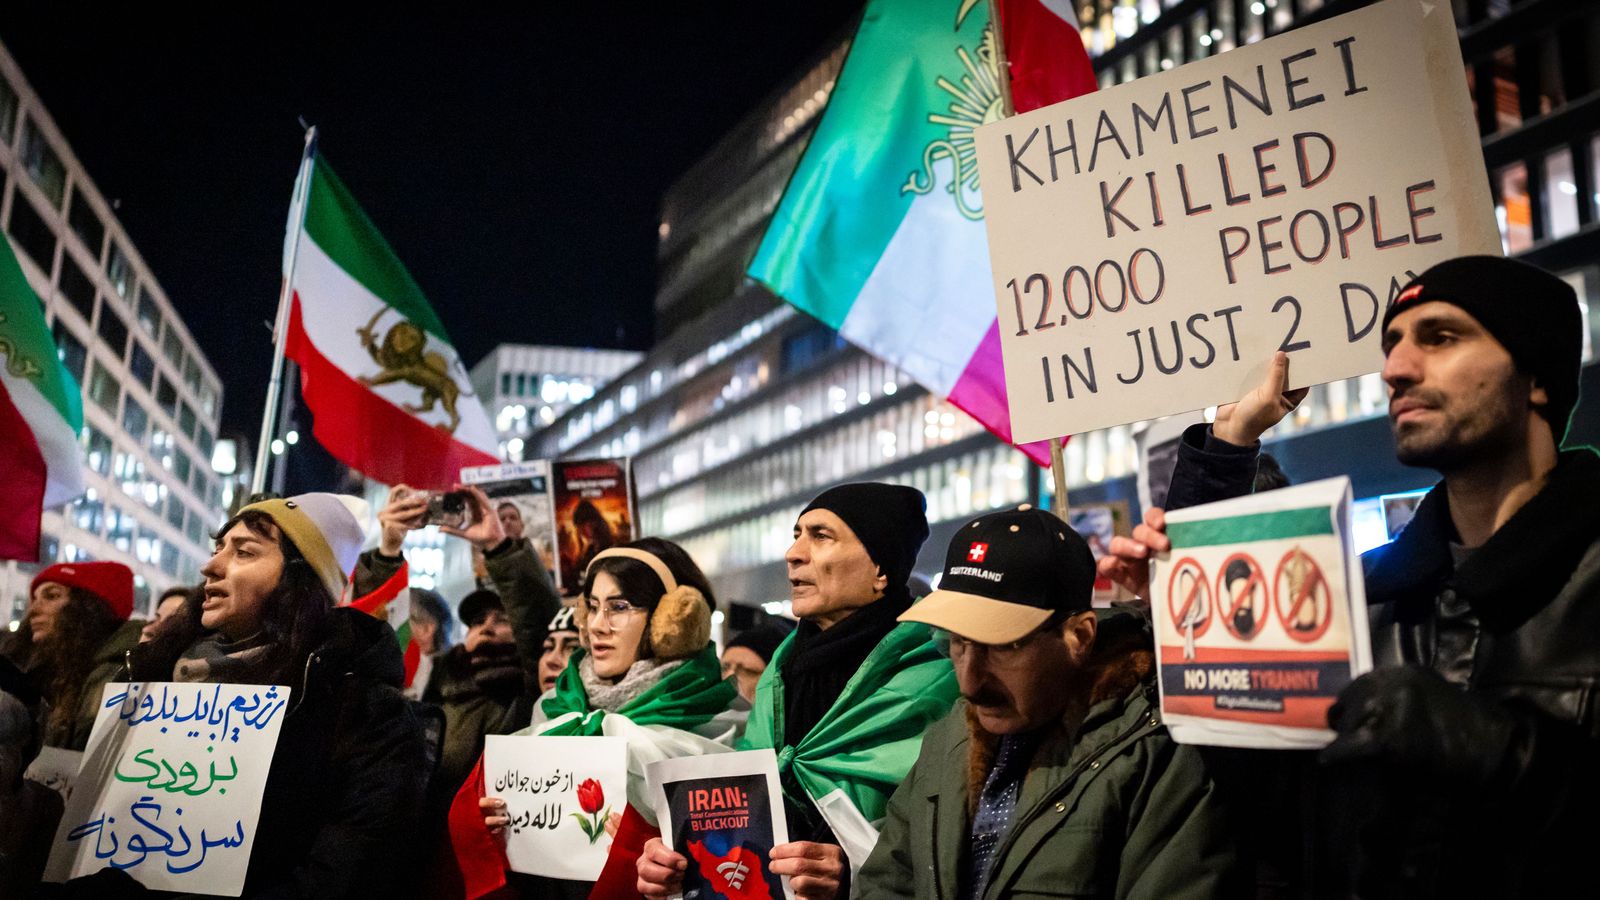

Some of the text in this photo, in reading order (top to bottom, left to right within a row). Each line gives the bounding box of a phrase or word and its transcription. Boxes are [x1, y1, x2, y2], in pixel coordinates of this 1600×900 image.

[1005, 36, 1368, 192] KHAMENEI
[1100, 132, 1336, 238] KILLED
[1218, 179, 1442, 285] PEOPLE
[1042, 270, 1418, 402] IN JUST 2 DA
[949, 566, 1002, 582] SWITZERLAND
[1184, 669, 1319, 691] NO MORE TYRANNY
[173, 684, 224, 741] باید
[221, 685, 286, 743] رژیم
[114, 745, 238, 796] بزودی
[495, 768, 573, 794] از خون جوانان
[530, 803, 562, 830] لاله
[688, 786, 749, 812] IRAN:
[691, 816, 749, 831] BLACKOUT
[67, 796, 244, 874] سرنگونه
